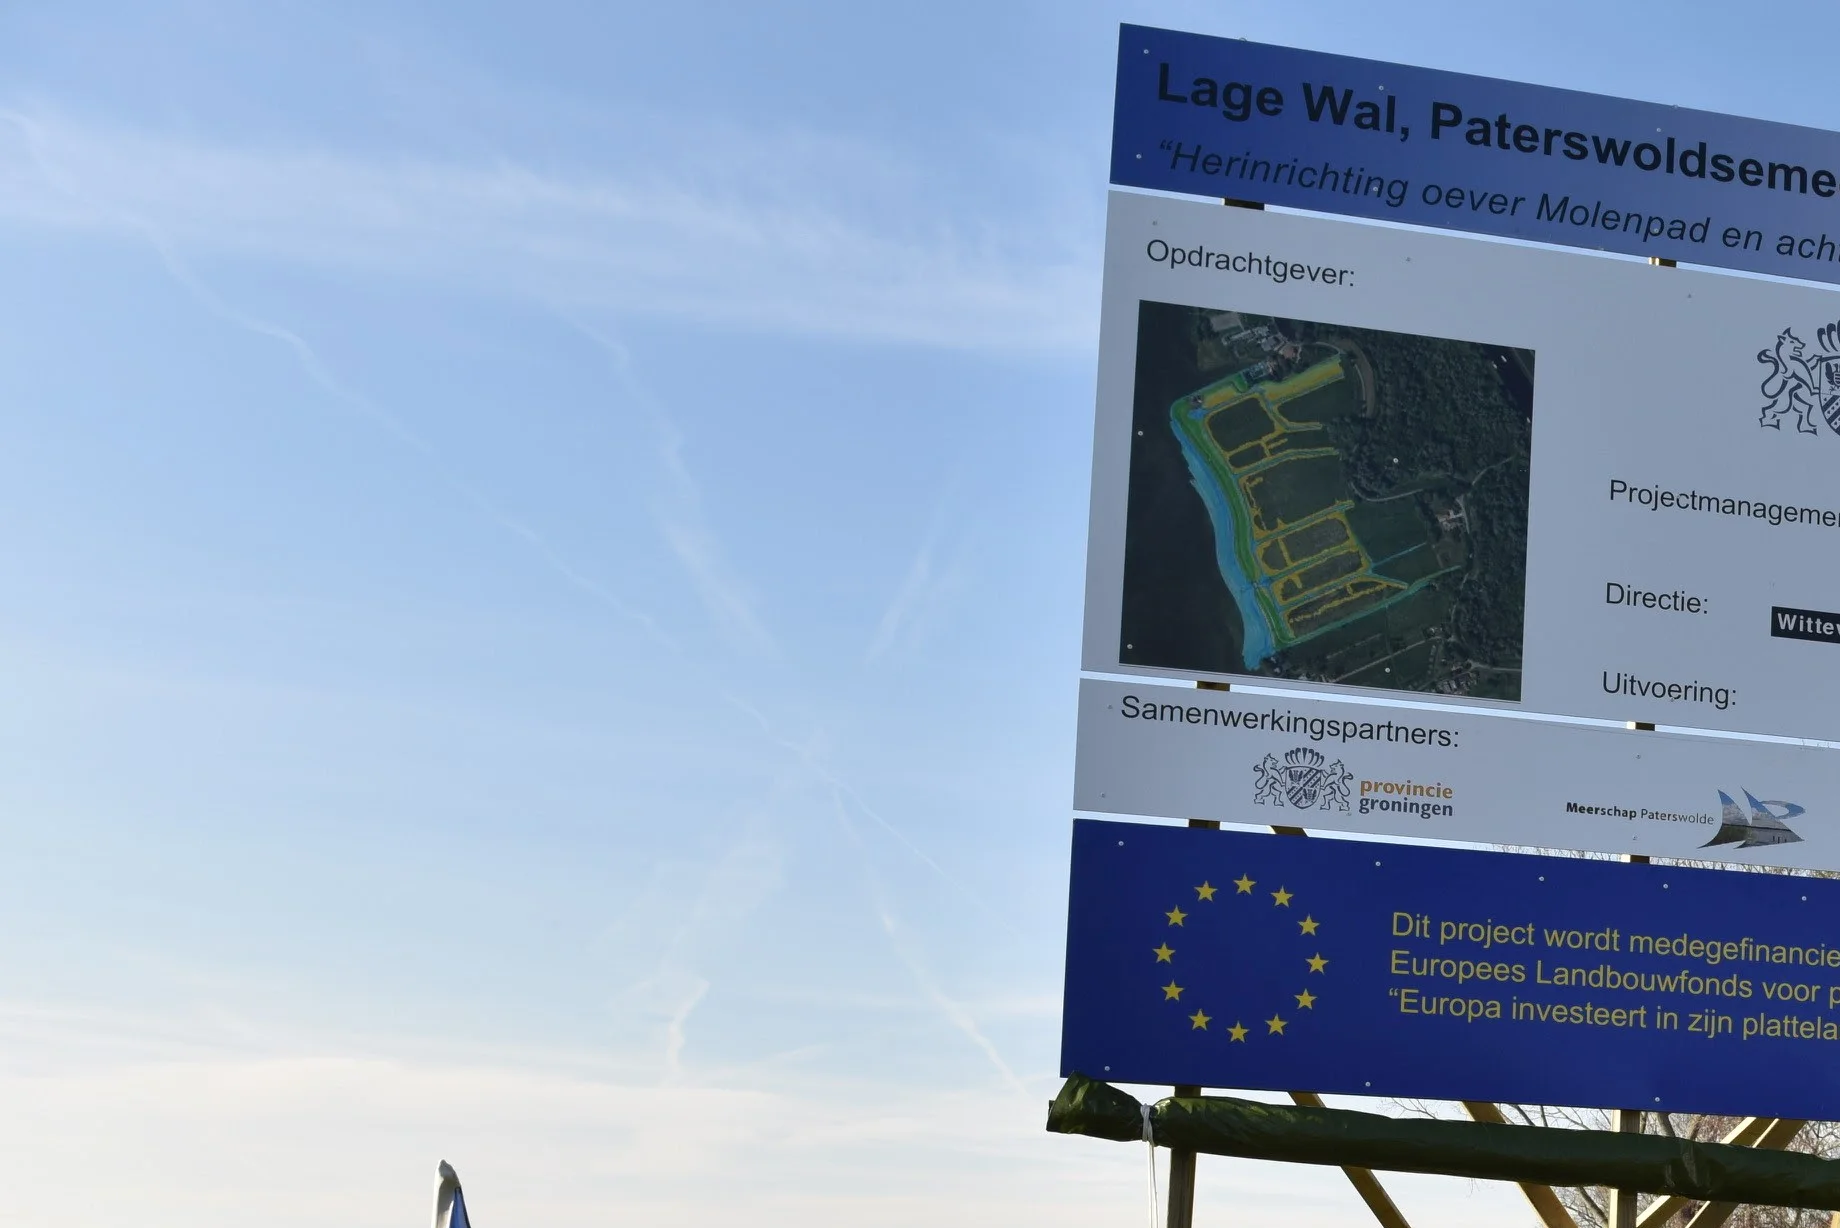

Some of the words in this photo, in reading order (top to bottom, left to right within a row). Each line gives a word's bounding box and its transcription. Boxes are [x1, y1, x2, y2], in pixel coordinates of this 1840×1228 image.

[1158, 62, 1284, 122] Lage
[1302, 82, 1409, 142] Wal,
[1159, 140, 1409, 208] “Herinrichting
[1421, 184, 1527, 217] oever
[1537, 193, 1711, 243] Molenpad
[1722, 224, 1763, 252] en
[1147, 239, 1355, 287] Opdrachtgever:
[1605, 581, 1708, 615] Directie:
[1602, 670, 1736, 708] Uitvoering:
[1121, 695, 1460, 748] Samenwerkingspartners:
[1359, 795, 1454, 820] groningen
[1360, 778, 1453, 800] provincie
[1566, 801, 1637, 820] Meerschap
[1641, 808, 1714, 826] Paterswolde
[1392, 911, 1431, 938] Dit
[1440, 919, 1535, 949] project
[1543, 927, 1621, 953] wordt
[1390, 950, 1526, 984] Europees
[1536, 961, 1753, 998] Landbouwfonds
[1762, 980, 1820, 1003] voor
[1389, 988, 1502, 1022] “Europa
[1511, 996, 1646, 1028] investeert
[1656, 1008, 1678, 1030] in
[1688, 1012, 1733, 1039] zijn
